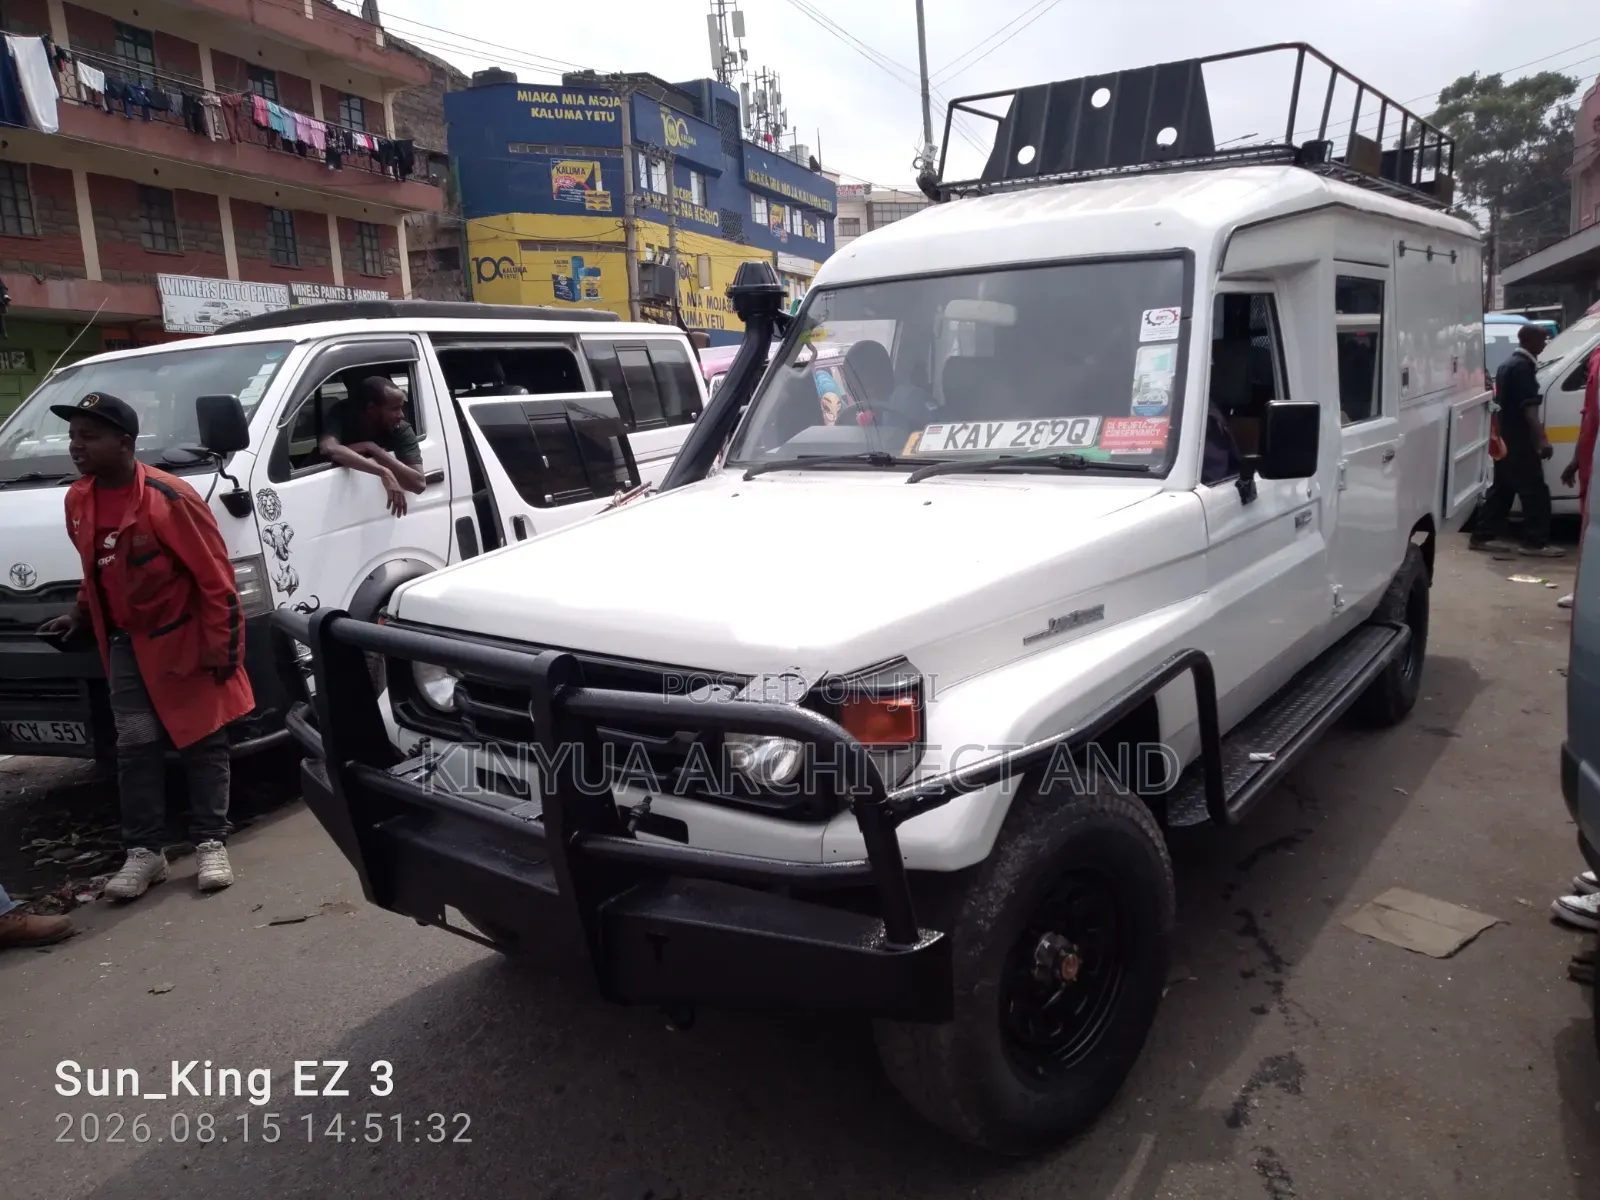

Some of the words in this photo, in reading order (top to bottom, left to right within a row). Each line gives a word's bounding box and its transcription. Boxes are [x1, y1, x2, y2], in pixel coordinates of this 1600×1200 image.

[517, 90, 559, 104] MIAKA
[562, 93, 586, 106] MIA
[589, 95, 622, 108] MOJA
[531, 107, 584, 121] KALUMA
[585, 110, 615, 122] YETU
[556, 166, 586, 175] KALUMA
[681, 202, 693, 219] NA
[694, 206, 719, 227] KESHO
[161, 277, 219, 299] WINNERS
[219, 281, 250, 301] AUTO
[250, 285, 287, 304] PAINTS
[291, 283, 319, 297] WINELS
[320, 285, 346, 300] PAINTS
[347, 288, 352, 300] &
[353, 289, 389, 301] HARDWARE
[707, 295, 727, 312] MOJA
[705, 312, 725, 329] YETU
[943, 422, 1003, 450] KAY
[1010, 418, 1090, 447] 289Q
